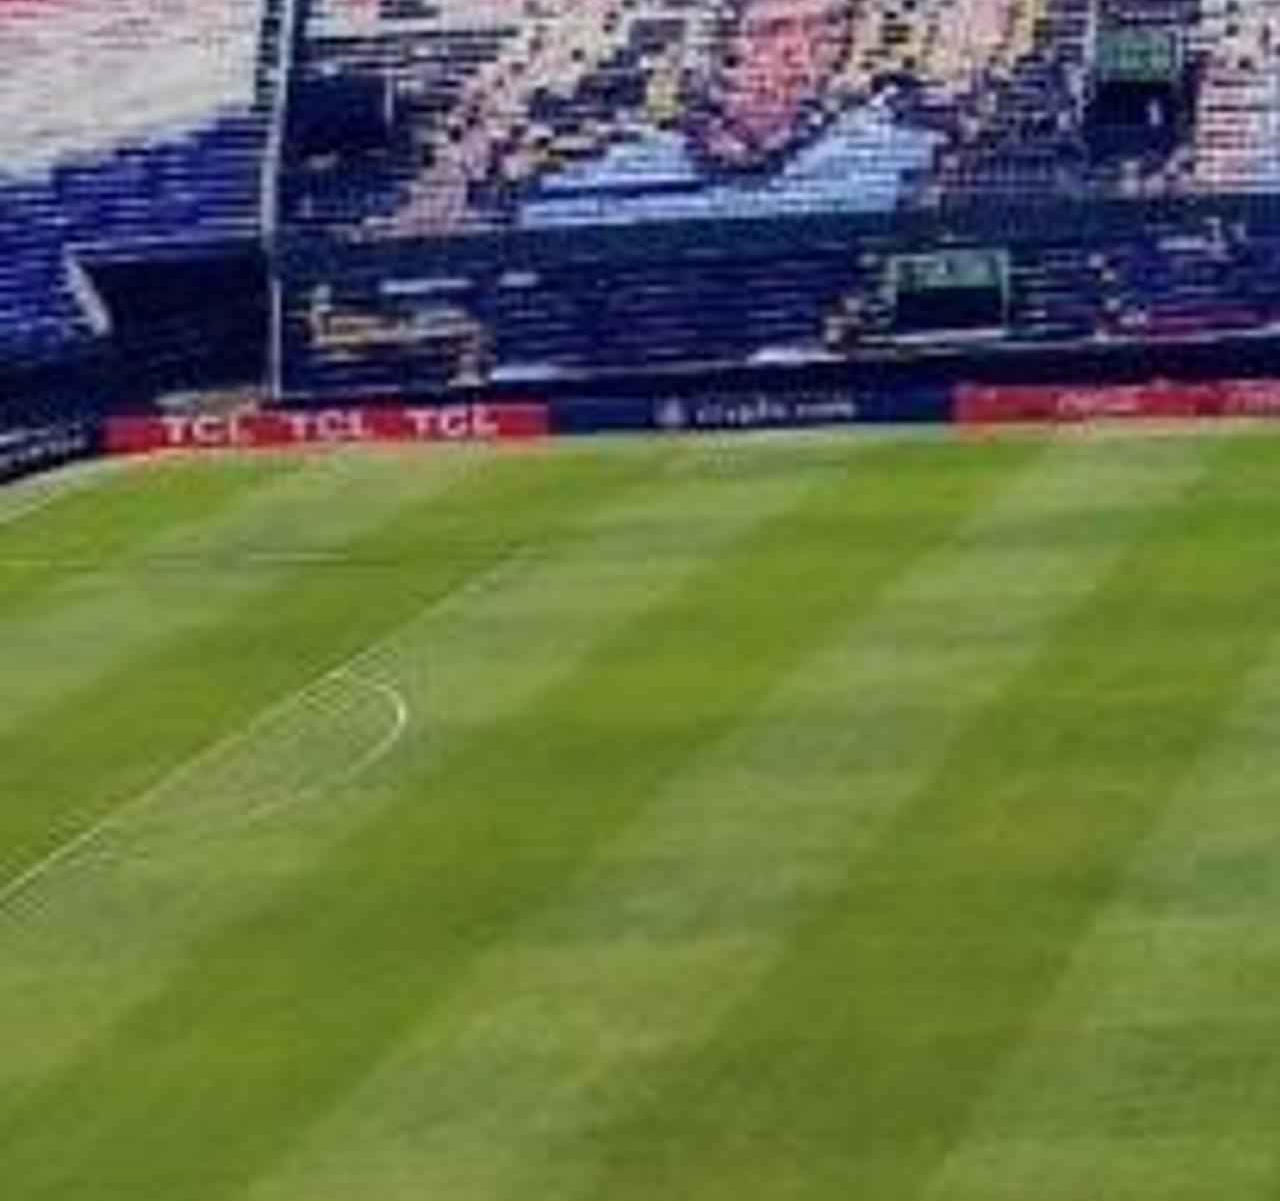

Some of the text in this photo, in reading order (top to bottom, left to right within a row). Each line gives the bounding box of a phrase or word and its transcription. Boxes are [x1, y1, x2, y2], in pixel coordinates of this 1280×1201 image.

[162, 404, 499, 445] TCL TCL TCL
